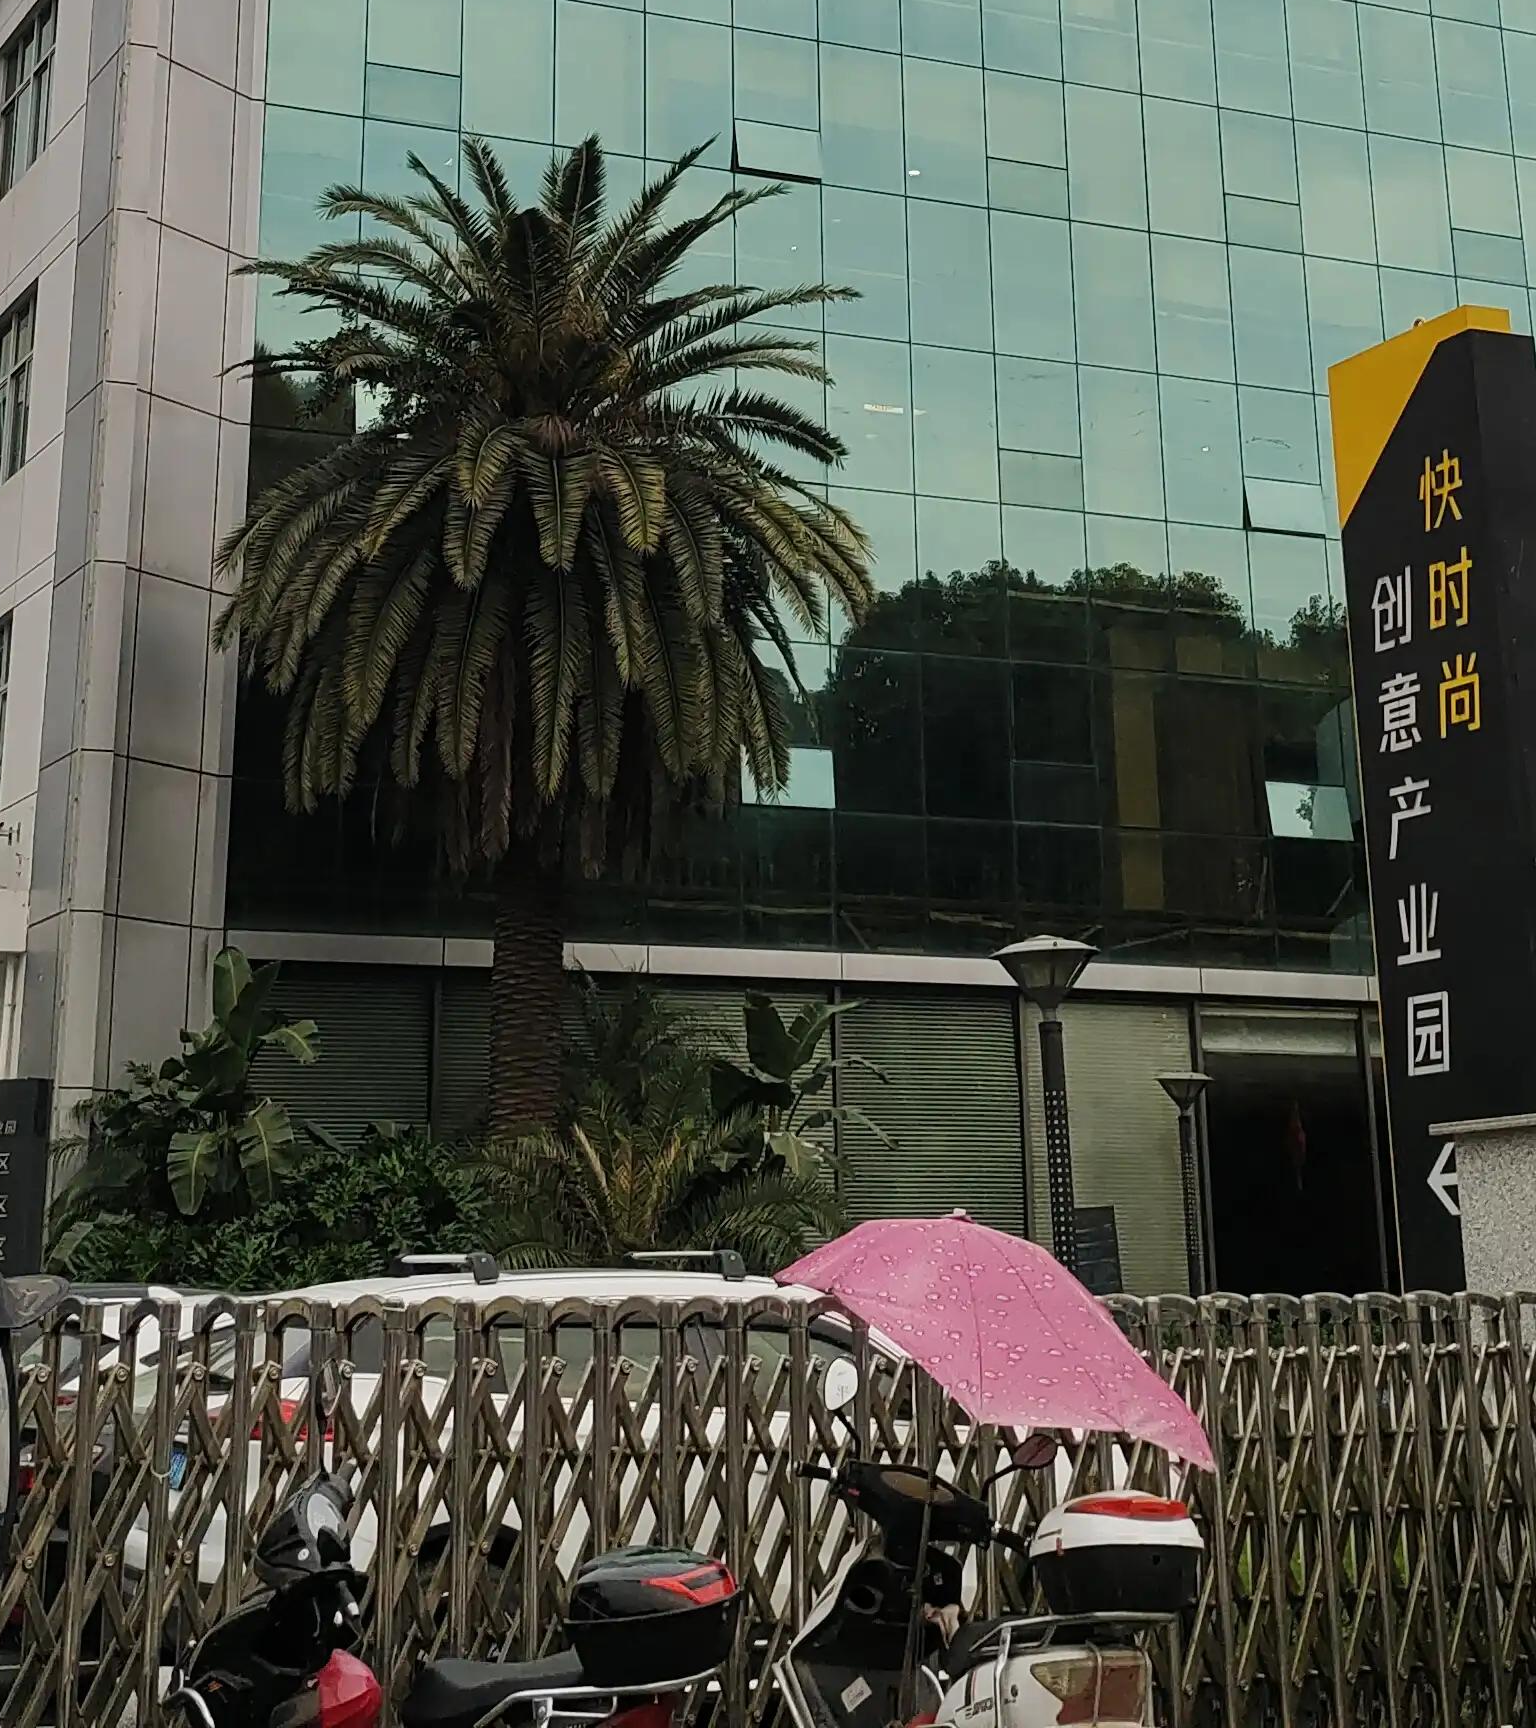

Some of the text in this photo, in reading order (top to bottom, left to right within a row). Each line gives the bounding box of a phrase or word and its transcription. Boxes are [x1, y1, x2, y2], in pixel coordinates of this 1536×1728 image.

[1419, 448, 1482, 735] 快时尚
[1370, 564, 1452, 1078] 创意产业园
